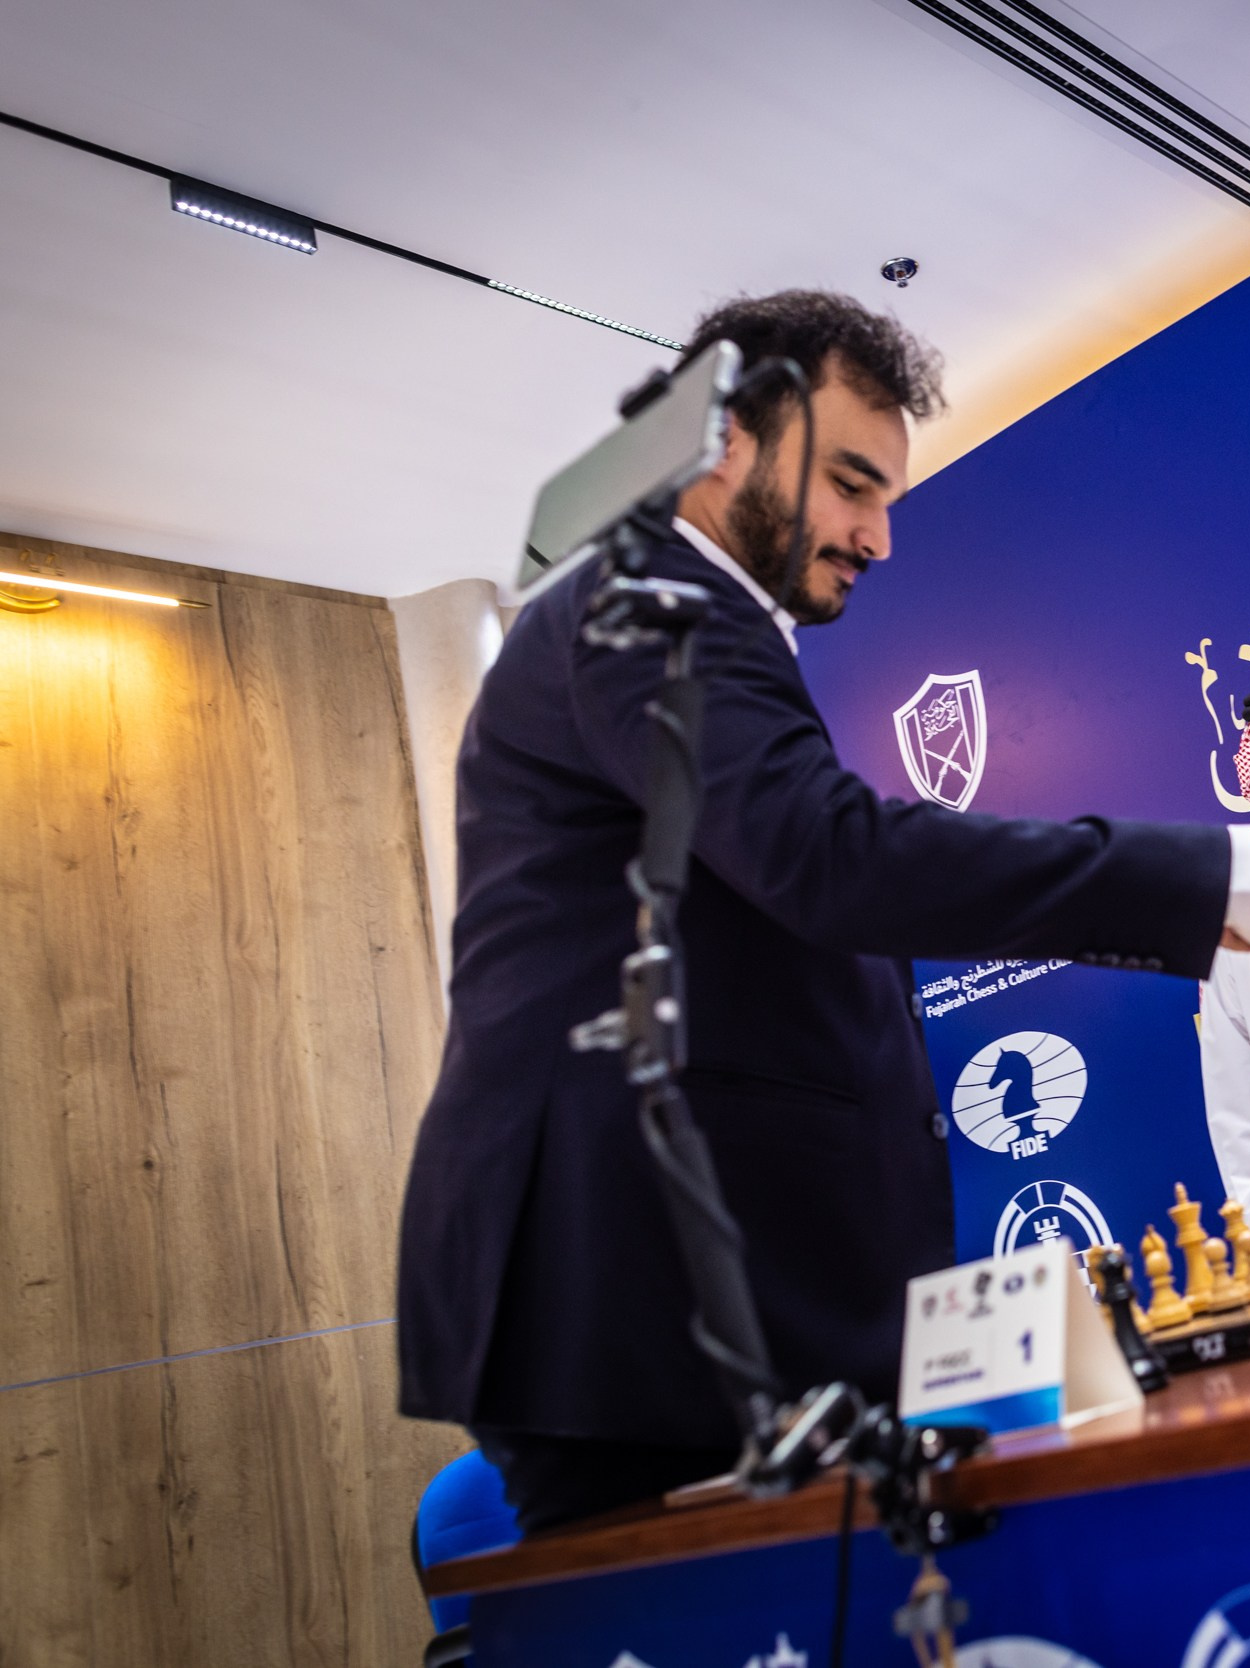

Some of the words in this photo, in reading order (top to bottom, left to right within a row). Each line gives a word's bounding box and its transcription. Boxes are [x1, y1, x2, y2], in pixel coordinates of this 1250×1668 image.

[925, 993, 966, 1018] Fujairah
[966, 983, 998, 1002] Chess
[998, 977, 1008, 990] &
[1008, 965, 1048, 986] Culture
[1010, 1132, 1049, 1160] FIDE
[1018, 1328, 1033, 1364] 1
